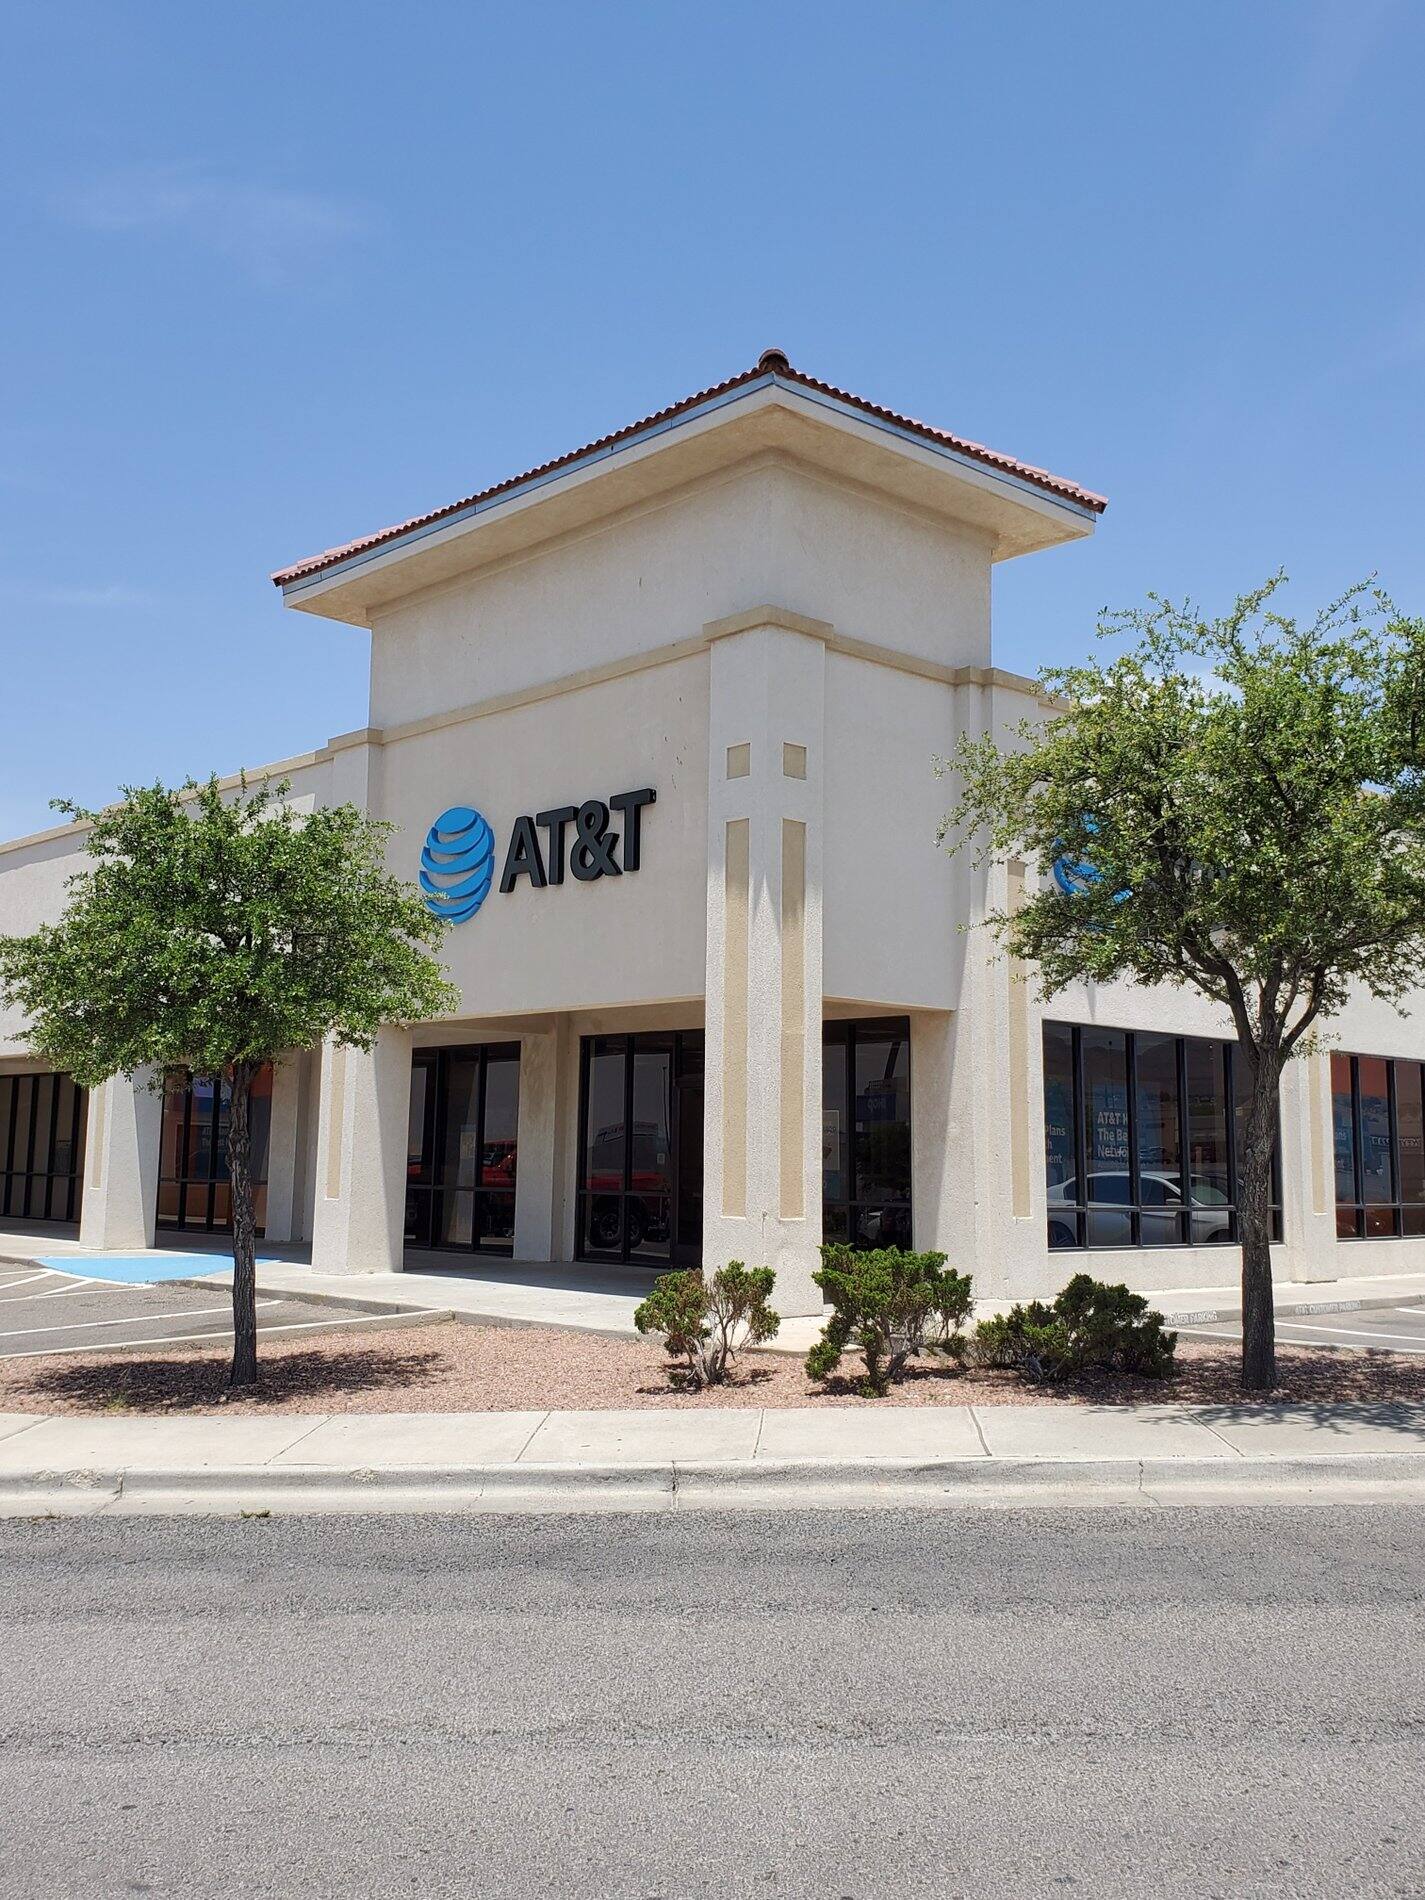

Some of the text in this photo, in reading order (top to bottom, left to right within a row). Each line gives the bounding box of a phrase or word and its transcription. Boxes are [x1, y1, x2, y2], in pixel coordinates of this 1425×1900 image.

[499, 788, 657, 893] AT&T
[1097, 1111, 1120, 1124] AT&T
[1098, 1128, 1128, 1141] The Be
[1097, 1145, 1128, 1158] Netwo
